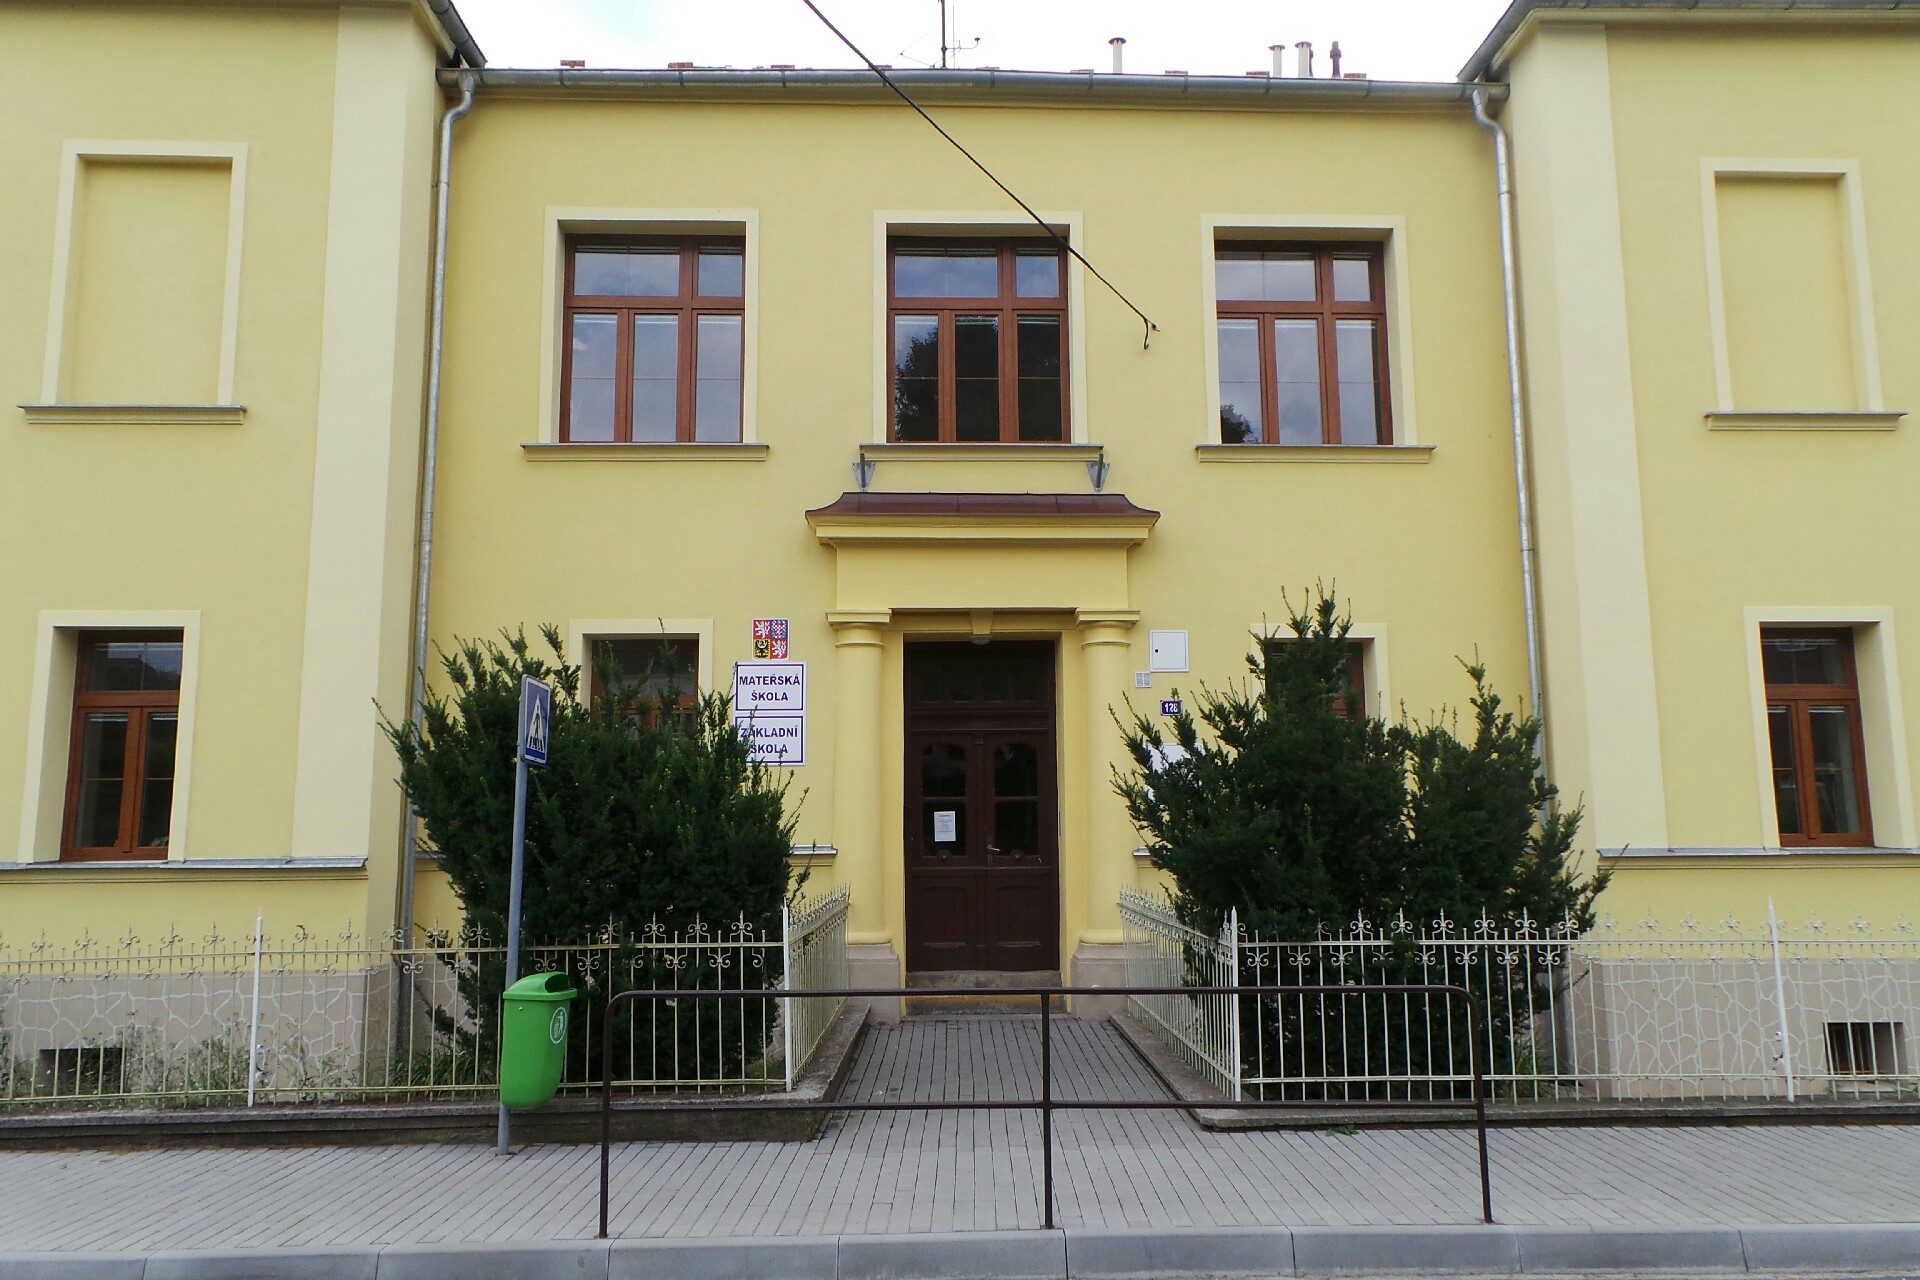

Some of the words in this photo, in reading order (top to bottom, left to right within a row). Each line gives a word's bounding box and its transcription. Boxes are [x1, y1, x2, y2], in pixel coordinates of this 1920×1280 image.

[739, 673, 800, 685] MATEŘSKÁ
[751, 689, 788, 701] ŠKOLA
[1164, 702, 1178, 713] 128
